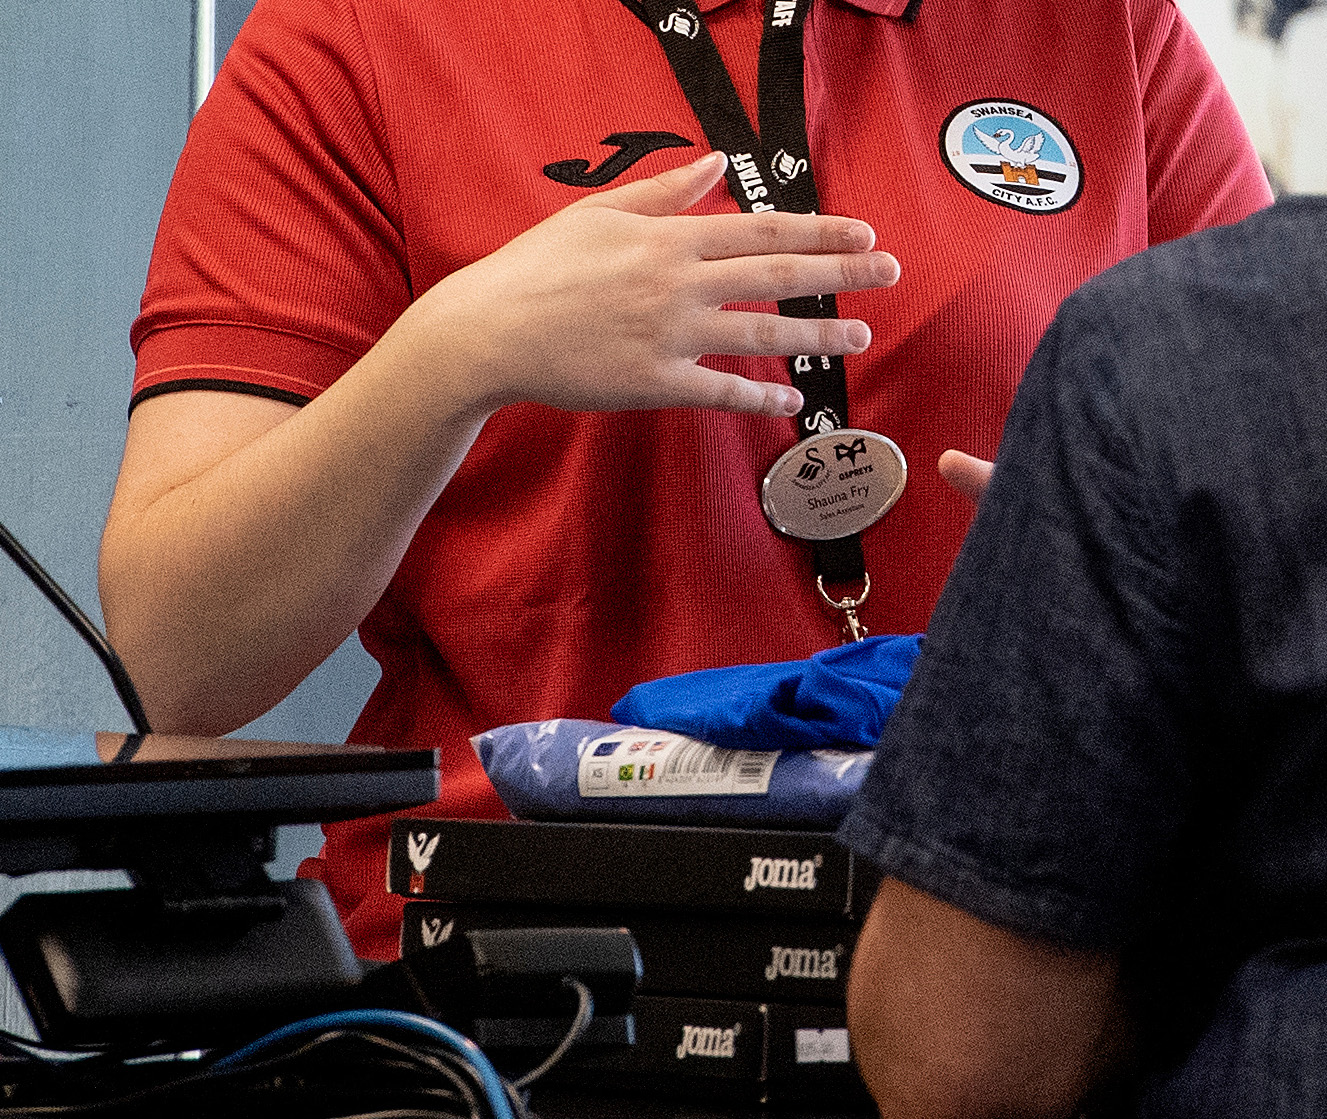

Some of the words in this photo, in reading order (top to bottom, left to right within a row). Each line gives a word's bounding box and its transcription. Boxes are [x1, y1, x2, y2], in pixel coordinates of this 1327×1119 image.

[970, 106, 1035, 121] SWANSEA
[730, 153, 768, 200] STAFF
[992, 188, 1022, 203] CITY
[838, 465, 873, 481] OSPREYS
[808, 491, 848, 511] Shauna
[850, 484, 870, 498] Fry
